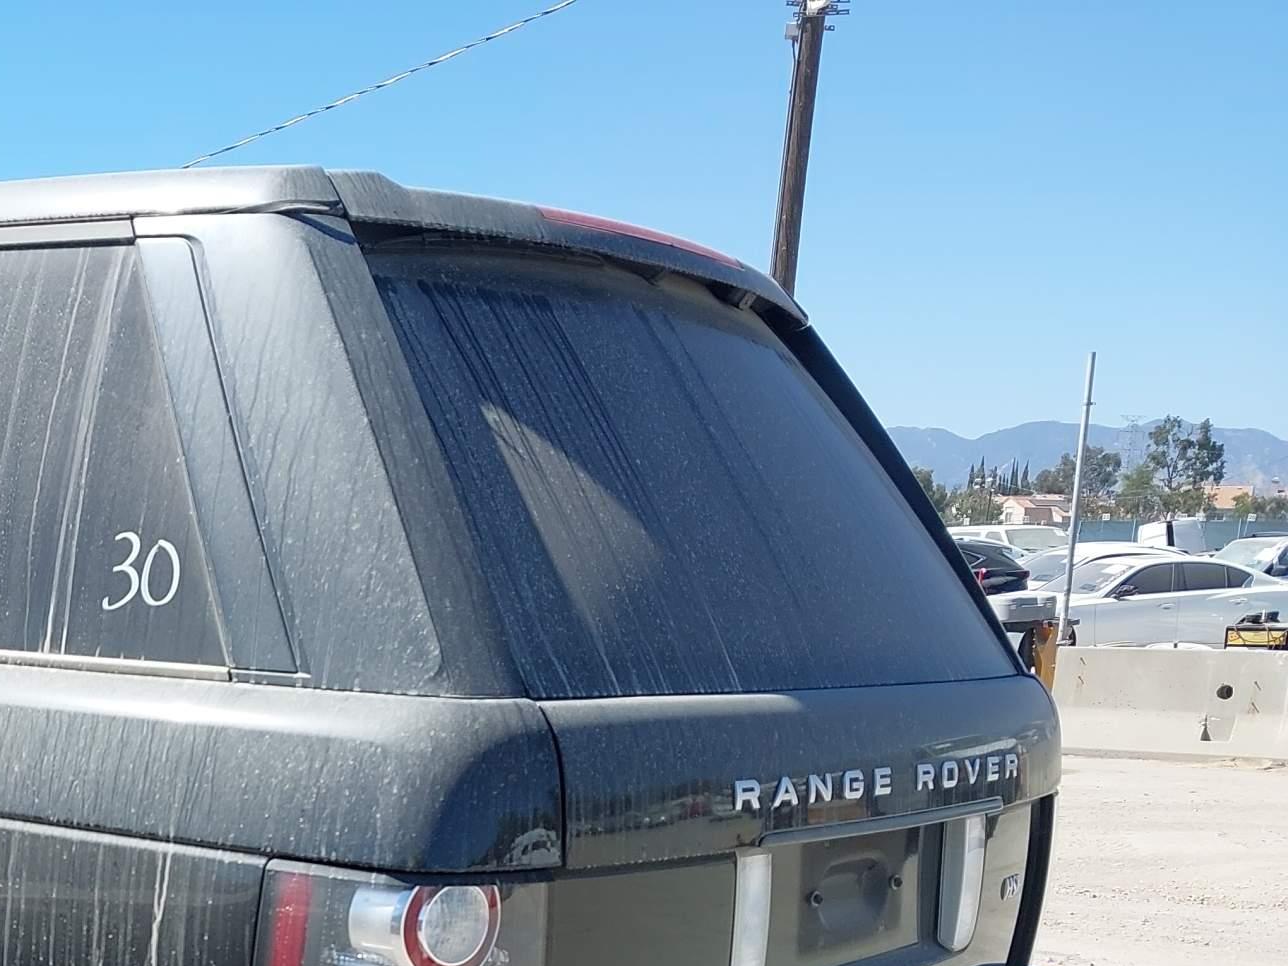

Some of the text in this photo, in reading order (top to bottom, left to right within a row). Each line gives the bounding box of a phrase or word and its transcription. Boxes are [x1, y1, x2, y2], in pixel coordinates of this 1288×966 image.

[102, 531, 181, 611] 30
[733, 752, 1019, 811] RANGE ROVER
